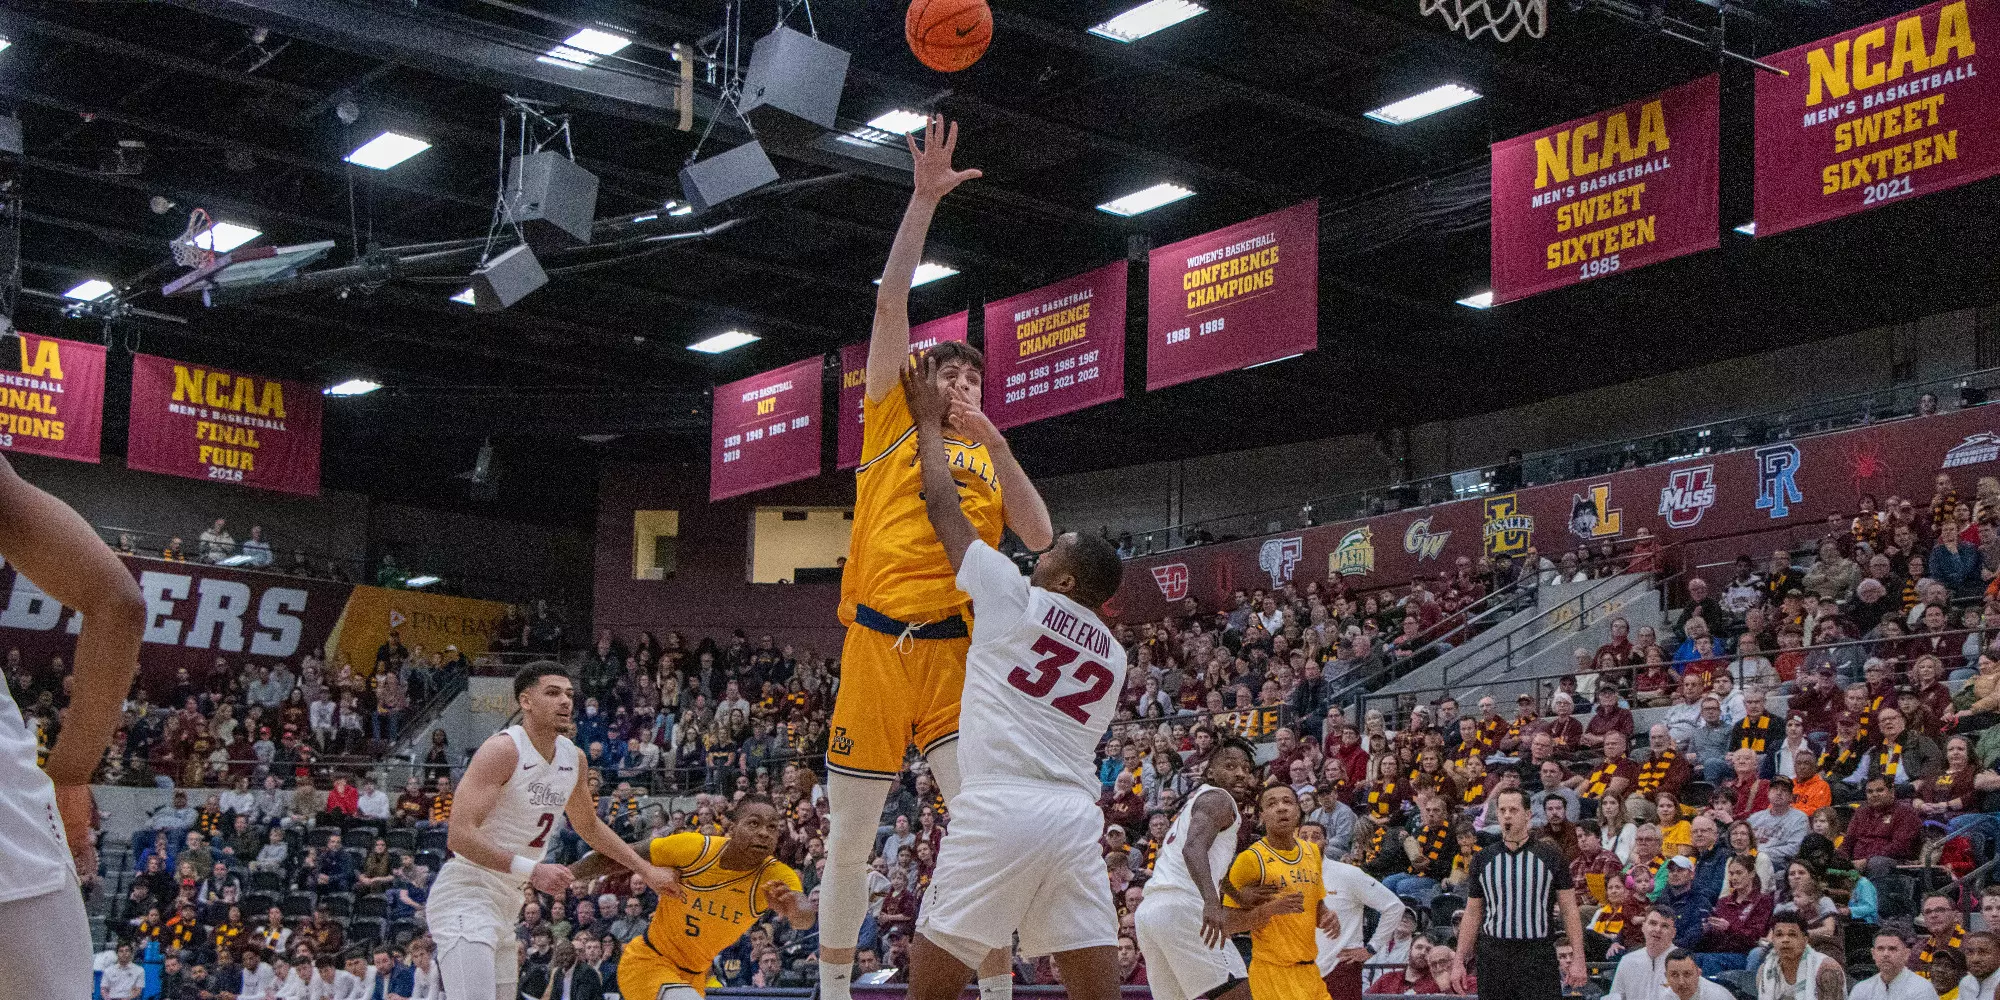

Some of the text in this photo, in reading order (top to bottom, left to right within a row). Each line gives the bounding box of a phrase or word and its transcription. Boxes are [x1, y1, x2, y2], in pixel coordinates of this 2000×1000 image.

[1806, 0, 1976, 107] NCAA
[1803, 63, 1977, 128] MEN'S BASKETBALL
[1835, 93, 1945, 154] SWEET
[1534, 99, 1670, 190] NCAA
[1822, 130, 1958, 196] SIXTEEN
[1531, 156, 1671, 209] MEN'S BASKETBALL
[1863, 175, 1914, 206] 2021
[1557, 182, 1646, 233] SWEET
[1187, 232, 1276, 269] WOMEN'S BASKETBALL
[1546, 214, 1656, 271] SIXTEEN
[1183, 245, 1280, 291] CONFERENCE
[1579, 254, 1620, 280] 1985
[1015, 289, 1094, 323] MEN'S BASKETBALL
[1187, 268, 1274, 309] CHAMPIONS
[1017, 303, 1090, 340] CONFERENCE
[1020, 322, 1086, 357] CHAMPIONS
[1166, 317, 1225, 345] 1988 1989
[1005, 367, 1099, 404] 2018 2019 2021 2022
[1006, 350, 1099, 387] 1980 1983 1985 1987
[172, 365, 286, 418] NCAA
[742, 381, 793, 403] MEN'S BASKETBALL
[757, 397, 776, 415] NIT
[169, 403, 286, 431] MEN'S BASKETBALL
[196, 421, 259, 449] FINAL
[199, 445, 254, 471] FOUR
[208, 466, 243, 482] 2018
[1588, 482, 1624, 540] L
[1659, 485, 1716, 515] MASS
[1404, 515, 1452, 562] GW
[1329, 546, 1374, 575] MASON
[411, 611, 458, 634] PNC
[1041, 605, 1111, 660] ADELEKUN
[1007, 634, 1115, 726] 32
[528, 813, 544, 848] 2
[685, 914, 701, 938] 5
